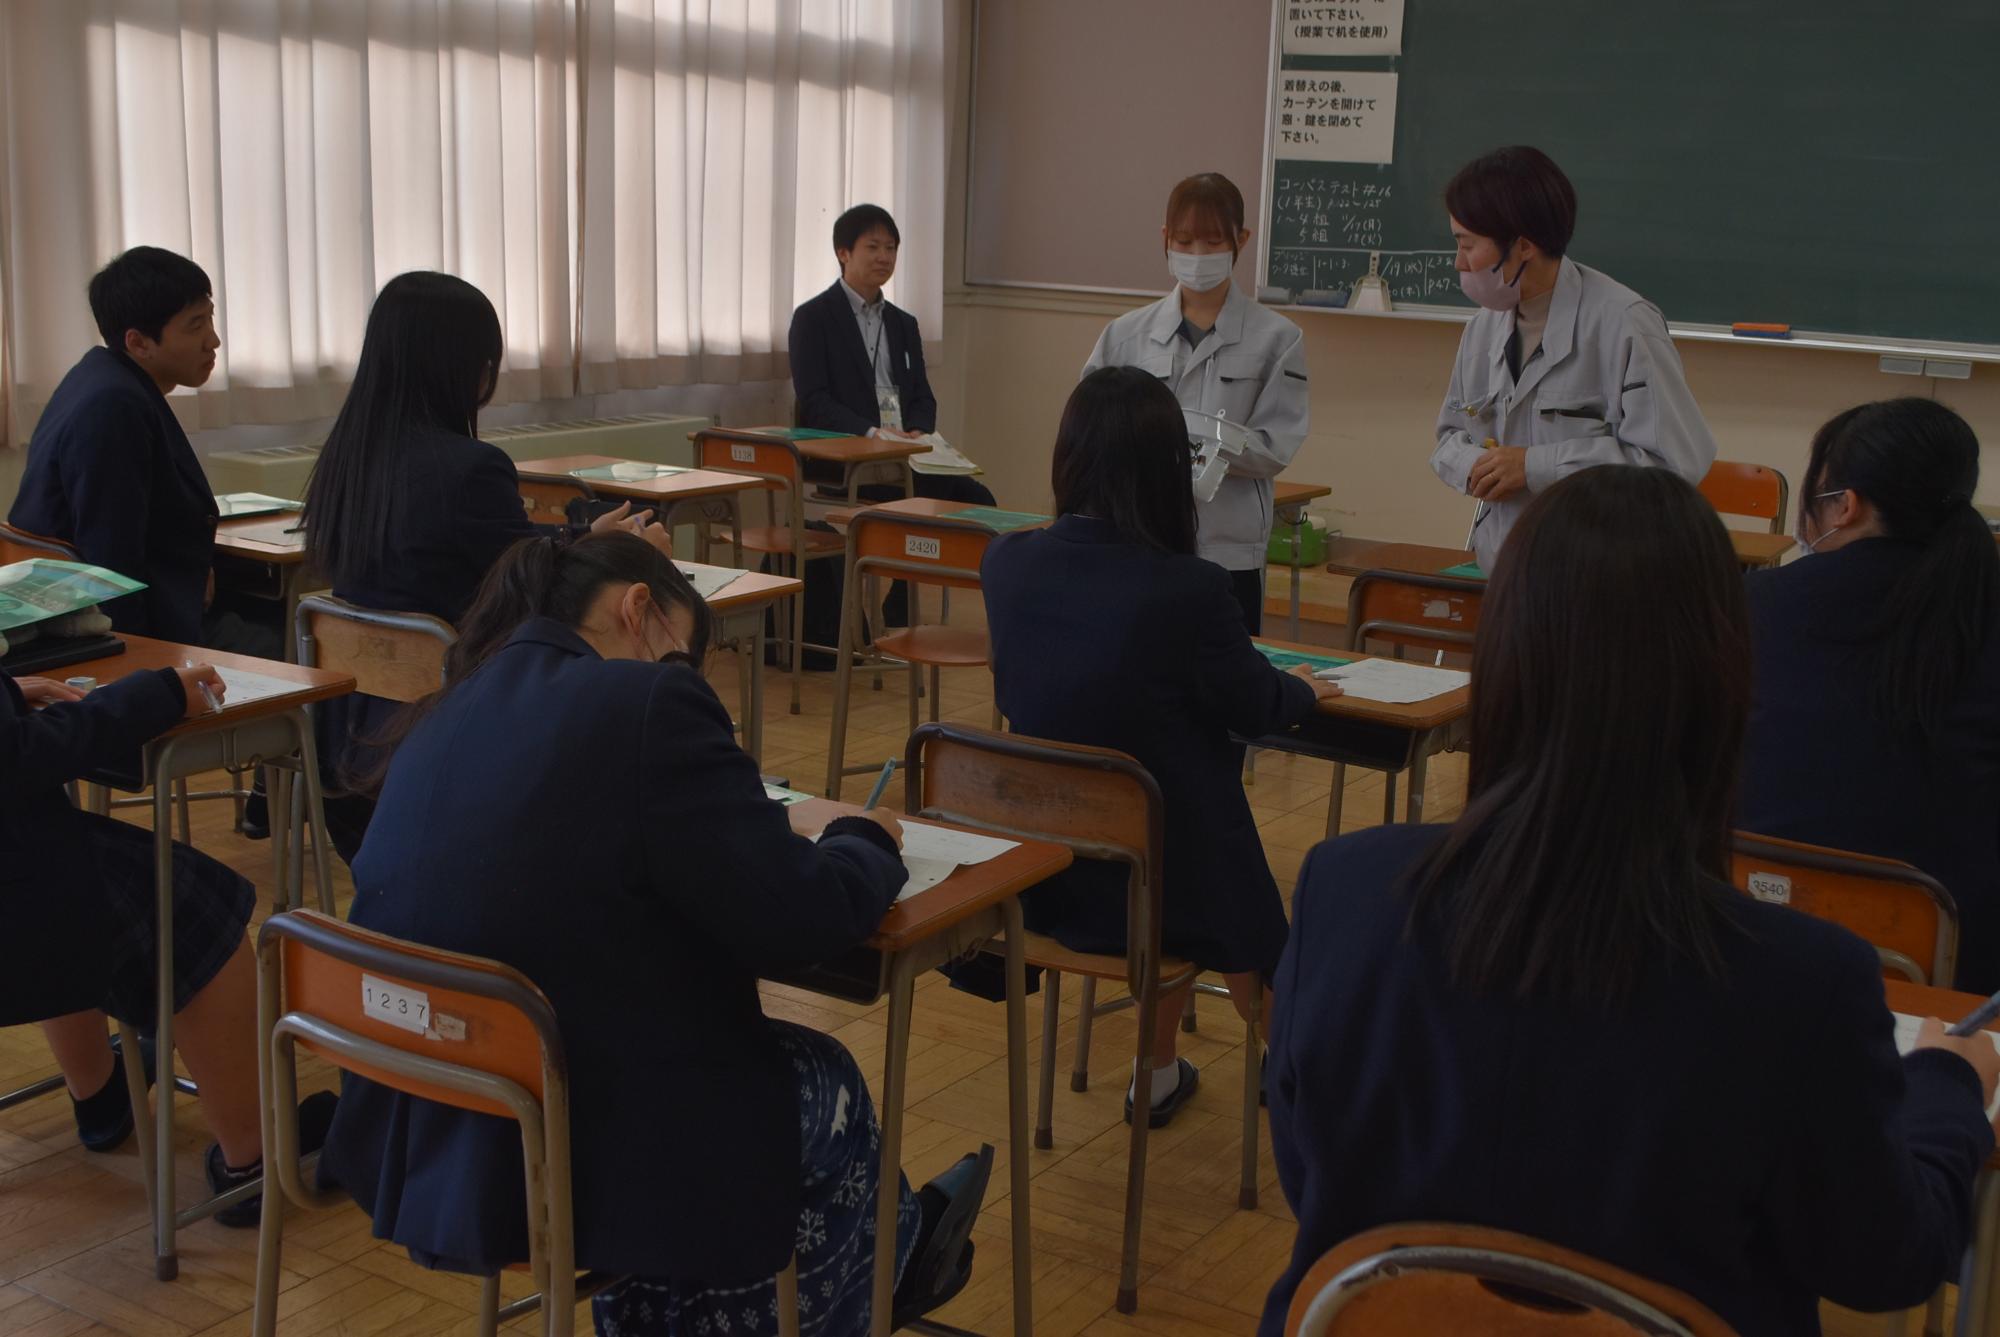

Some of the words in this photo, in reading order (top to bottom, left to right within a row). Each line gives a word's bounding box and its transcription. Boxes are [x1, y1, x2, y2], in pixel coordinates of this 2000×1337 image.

[1289, 8, 1365, 21] 置いて下さい。
[1283, 96, 1376, 111] カーテンを開けて
[1281, 130, 1319, 144] 下さい。
[909, 540, 938, 554] 2420
